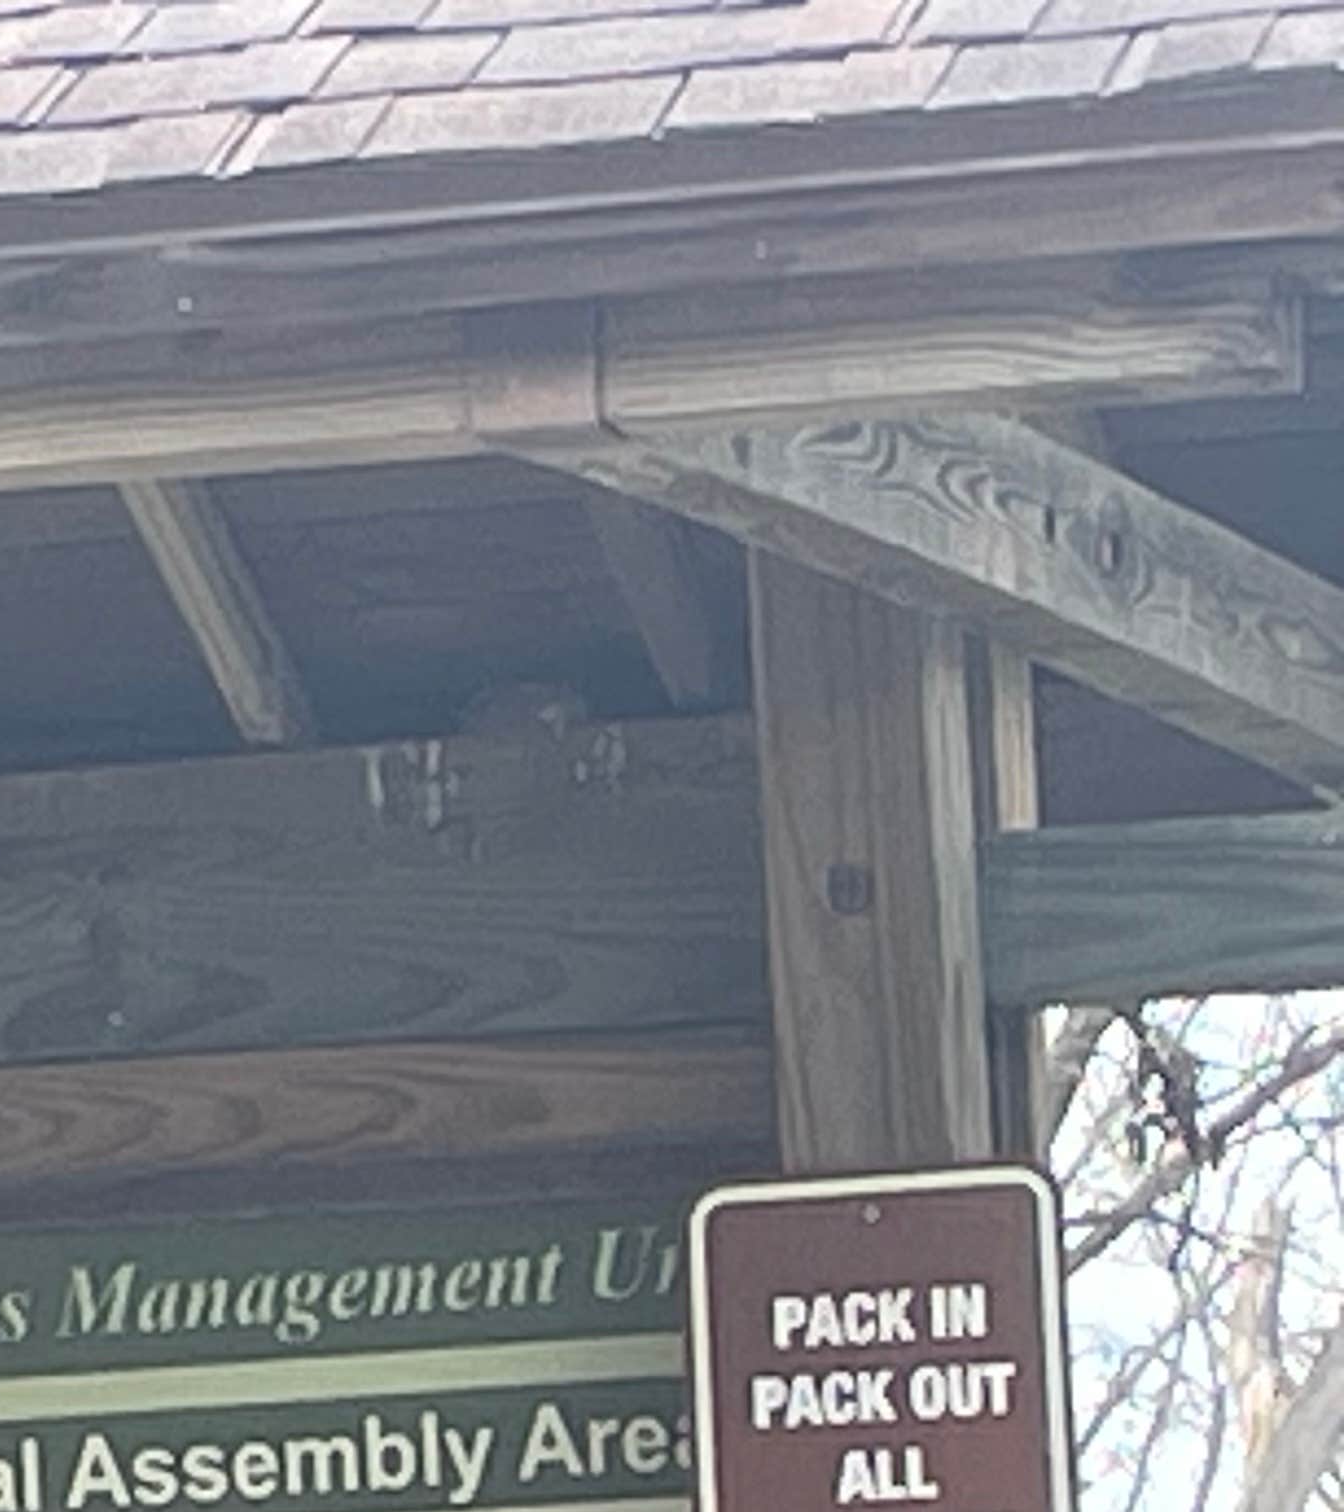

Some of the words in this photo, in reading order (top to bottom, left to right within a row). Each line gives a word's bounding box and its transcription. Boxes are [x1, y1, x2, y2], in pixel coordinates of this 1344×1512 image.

[56, 1244, 562, 1344] Management
[772, 1289, 915, 1350] PACK
[930, 1284, 986, 1339] IN
[751, 1370, 897, 1430] PACK
[910, 1362, 1017, 1421] OUT
[67, 1411, 493, 1510] Assembly
[837, 1446, 938, 1504] ALL
